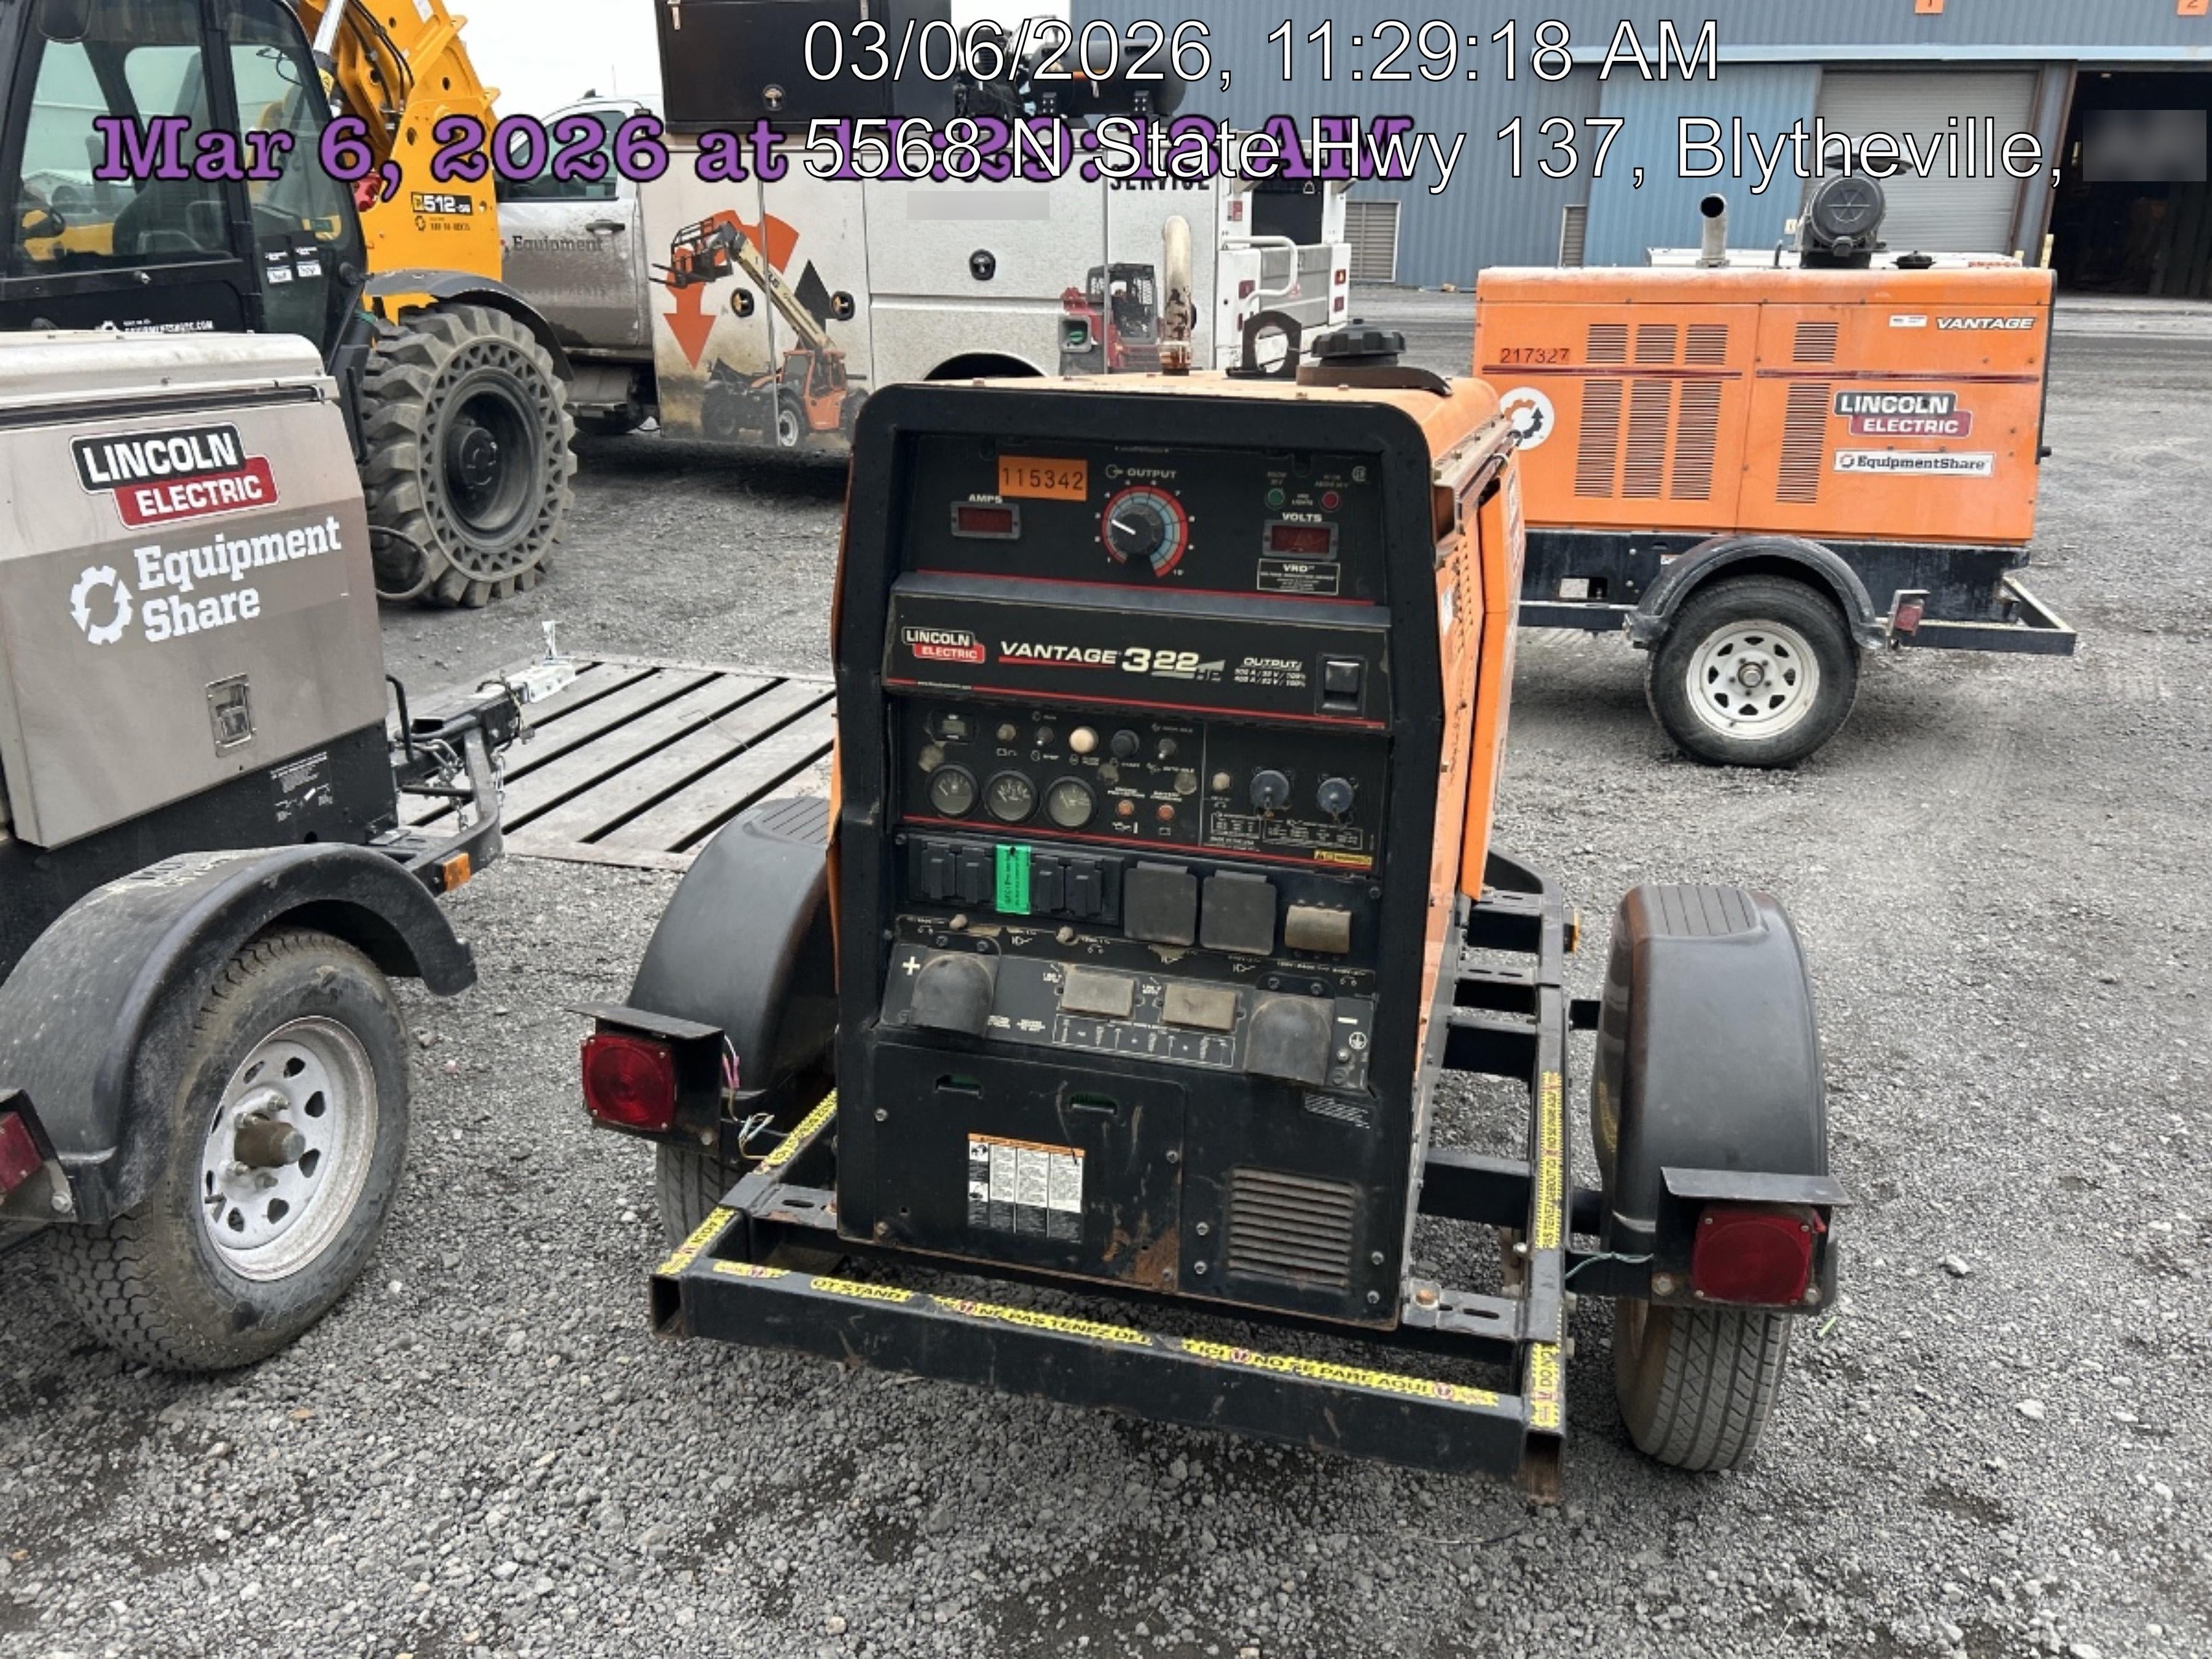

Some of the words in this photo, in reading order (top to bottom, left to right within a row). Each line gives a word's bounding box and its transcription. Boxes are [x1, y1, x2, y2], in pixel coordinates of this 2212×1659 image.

[512, 235, 603, 252] Equipment
[1936, 317, 2036, 329] VANTAGE
[1500, 348, 1570, 364] 217327
[1841, 395, 1949, 414] LINCOLN
[1863, 418, 1959, 434] ELECTRIC
[82, 432, 238, 484] LINCOLN
[1857, 455, 1986, 471] EquipmentShare
[1002, 467, 1083, 491] 115342
[1127, 468, 1177, 479] OUTPUT
[134, 475, 263, 517] ELECTRIC
[968, 493, 1003, 504] AMPS
[1282, 512, 1323, 522] VOLTS
[134, 516, 342, 593] Equipment
[142, 587, 261, 643] Share
[906, 630, 971, 646] LINCOLN
[922, 646, 978, 660] ELECTRIC
[1000, 641, 1118, 665] VANTAGE
[1121, 646, 1200, 672] 322
[1009, 1312, 1046, 1325] PAS
[1050, 1319, 1111, 1336] TENEZ
[1254, 1355, 1284, 1367] NO
[1320, 1367, 1375, 1383] PARE
[1378, 1378, 1429, 1392] AQUI
